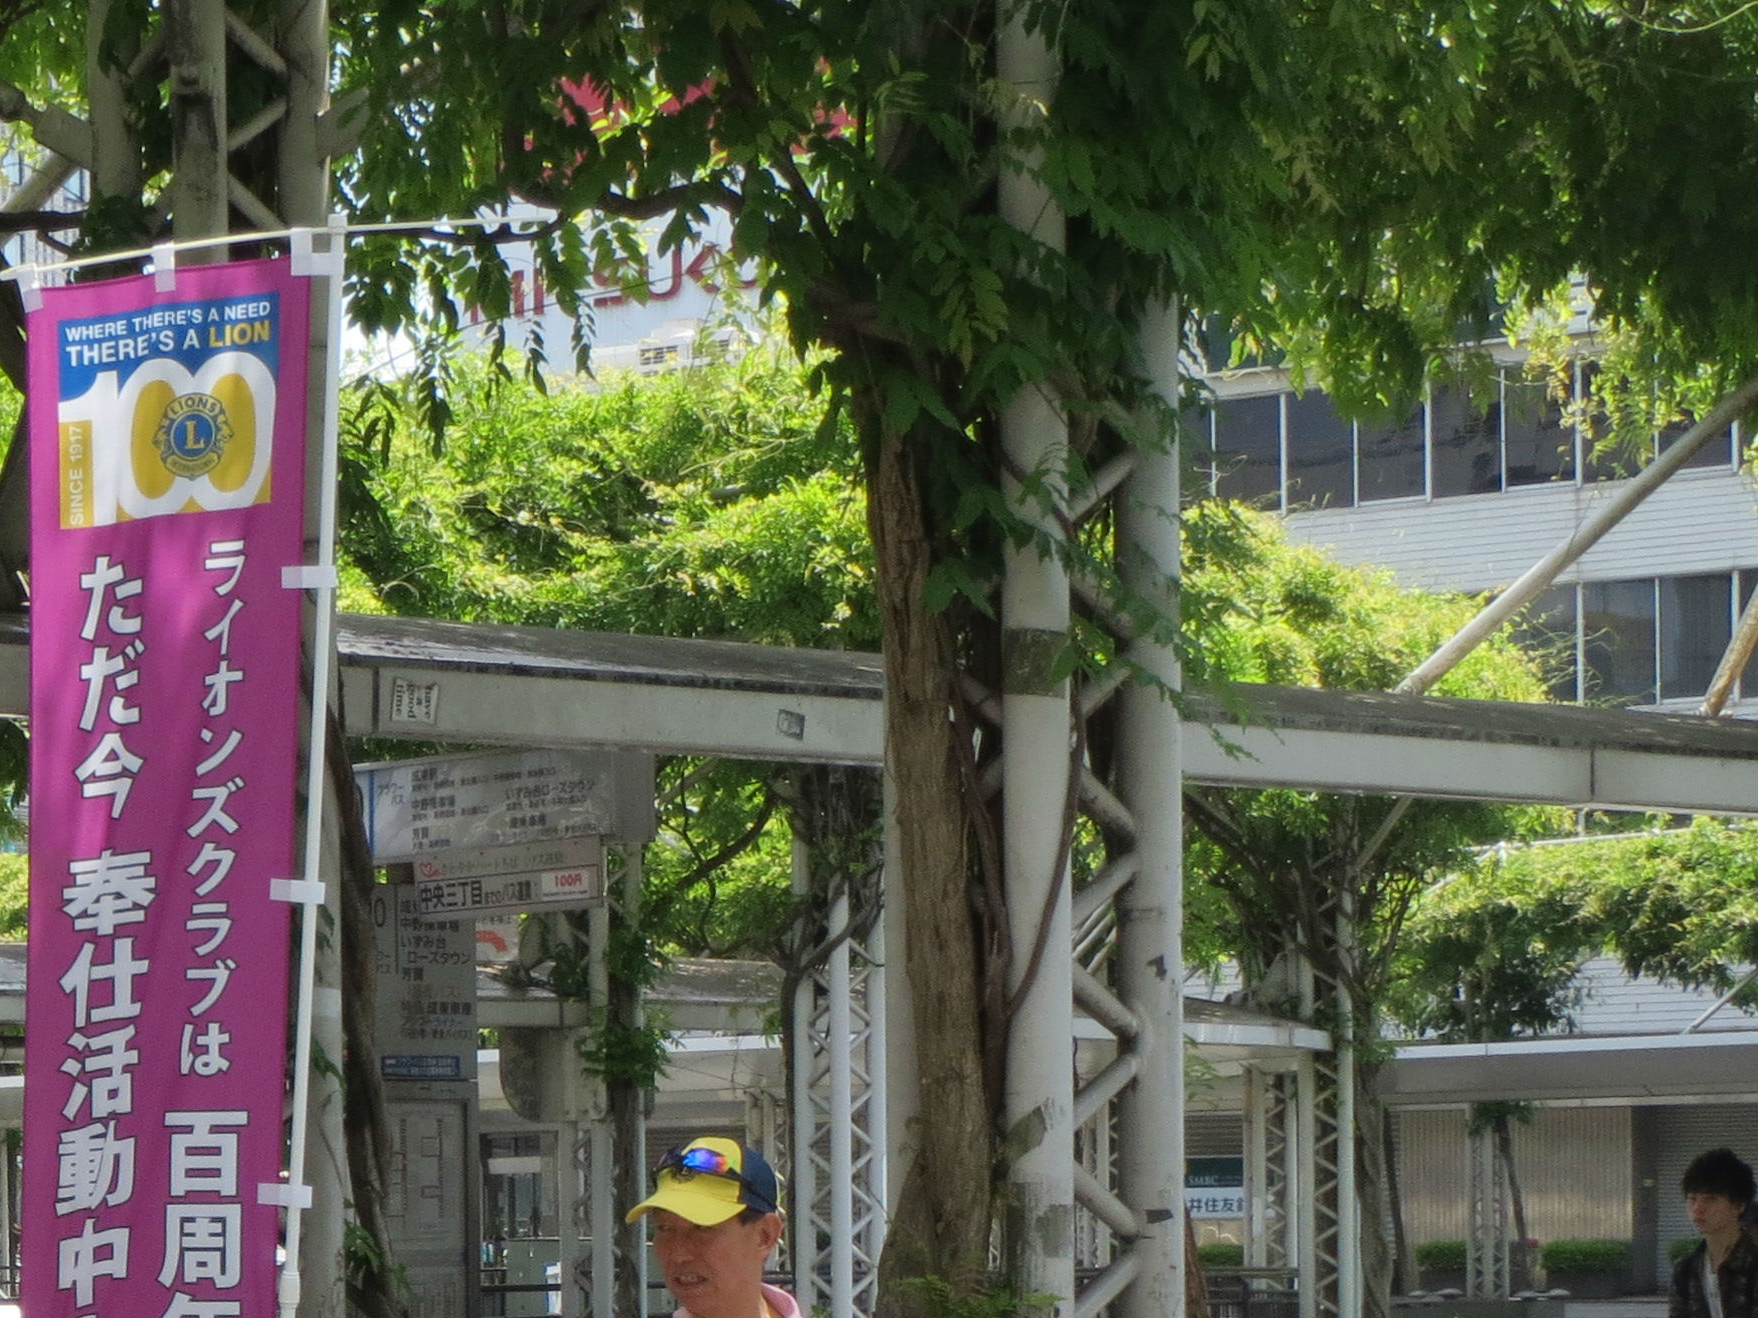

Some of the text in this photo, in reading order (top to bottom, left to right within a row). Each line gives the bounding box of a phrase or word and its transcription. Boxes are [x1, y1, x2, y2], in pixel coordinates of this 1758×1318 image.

[65, 301, 271, 342] WHERE THERE'S A NEED
[65, 319, 271, 368] THERE'S A LION
[169, 397, 218, 416] LIONS
[58, 350, 277, 527] 100
[69, 425, 84, 526] SINCE 1917
